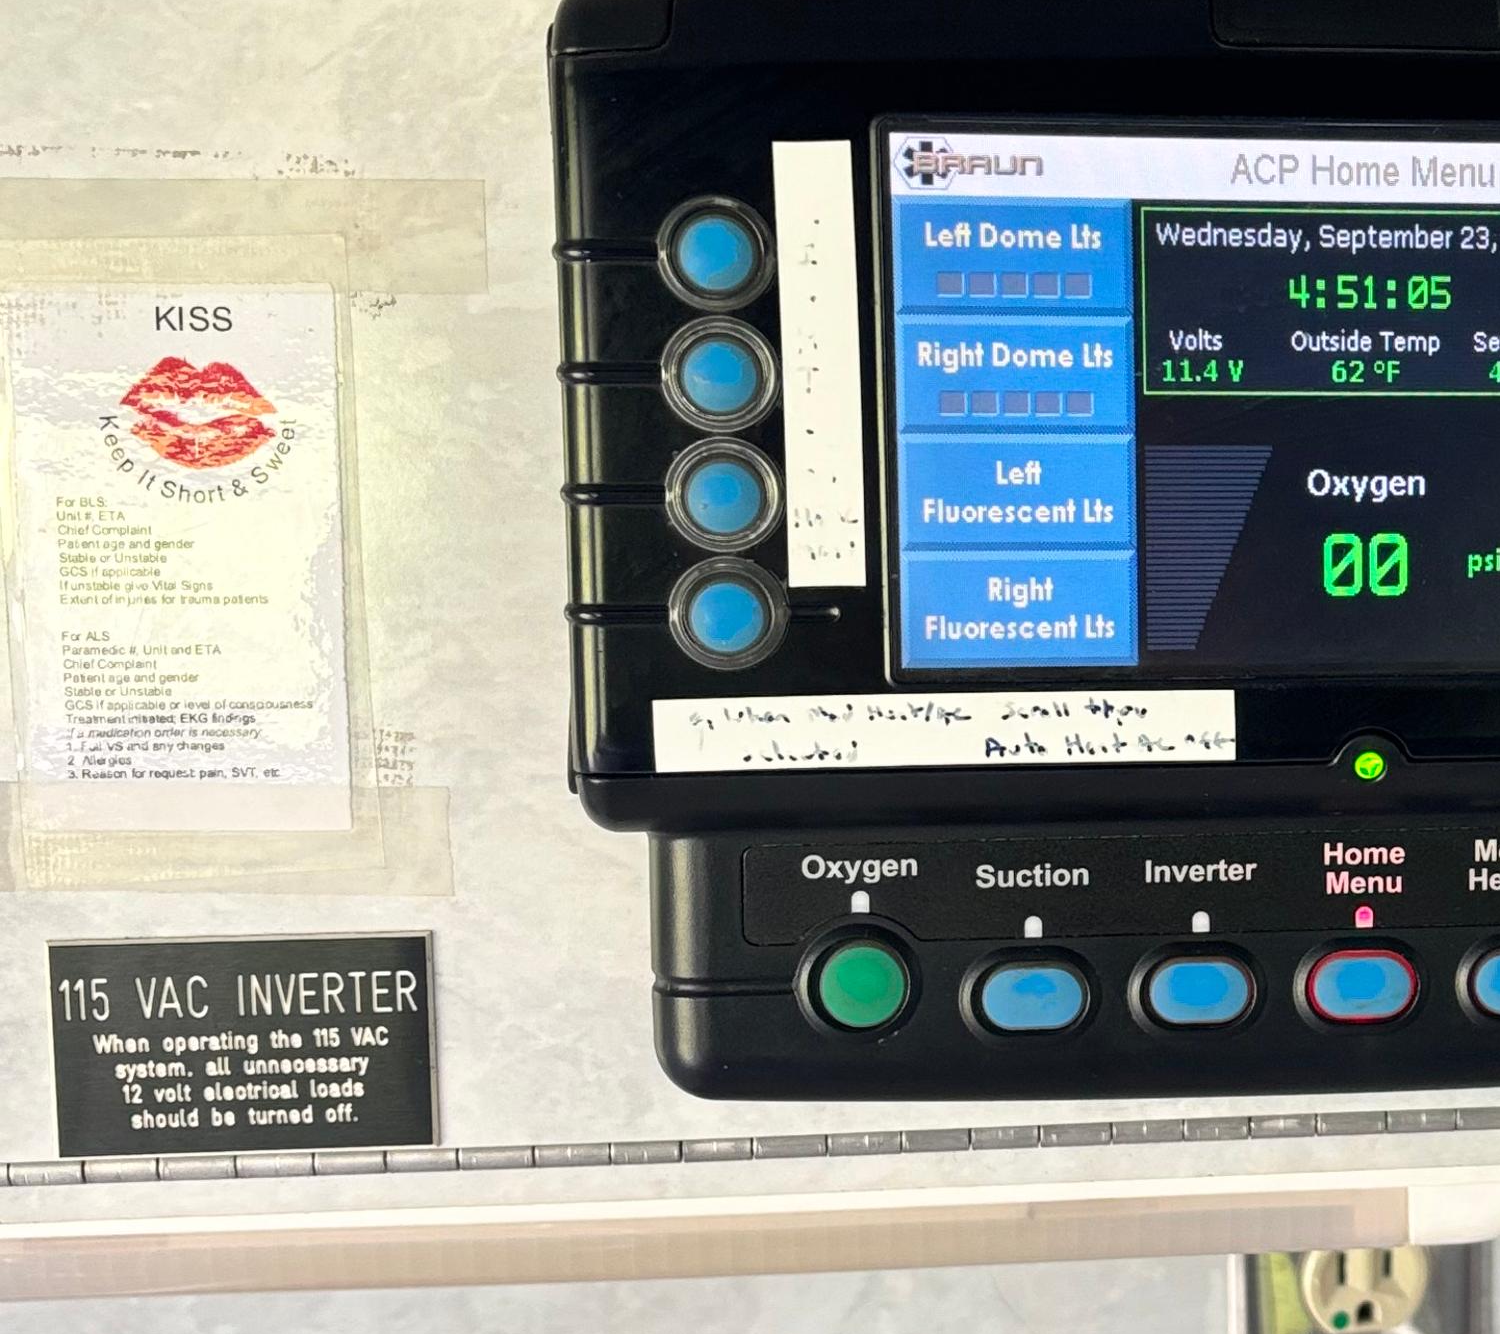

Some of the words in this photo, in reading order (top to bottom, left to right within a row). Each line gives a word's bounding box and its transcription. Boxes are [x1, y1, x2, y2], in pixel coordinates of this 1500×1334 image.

[912, 151, 1045, 177] BRAUN
[1230, 152, 1300, 186] ACP
[1310, 153, 1400, 187] Home
[1410, 155, 1497, 189] Menu
[924, 221, 971, 251] Left
[979, 223, 1062, 251] Dome
[1069, 223, 1103, 251] Lts
[1154, 221, 1312, 254] Wednesday,
[1318, 223, 1454, 254] September
[1459, 226, 1499, 254] 23,
[1287, 274, 1453, 311] 4:51:05
[154, 304, 234, 333] KISS
[1168, 328, 1223, 352] Volts
[1290, 330, 1373, 354] Outside
[1378, 331, 1442, 356] Temp
[917, 341, 985, 374] Right
[991, 344, 1074, 369] Dome
[1081, 343, 1114, 370] Lts
[1161, 359, 1219, 384] 11.4
[1227, 359, 1245, 384] V
[1330, 359, 1365, 385] 62
[98, 415, 136, 474] Keep
[136, 468, 157, 492] It
[159, 479, 227, 505] Short
[230, 478, 249, 498] &
[250, 418, 298, 485] Sweet
[995, 460, 1043, 487] Left
[1306, 468, 1426, 502] Oxygen
[55, 496, 76, 508] For
[922, 499, 1076, 524] Fluorescent
[1082, 499, 1115, 524] Lts
[55, 510, 81, 522] Unit
[98, 510, 126, 522] ETA
[57, 523, 90, 536] Chief
[91, 523, 153, 537] Complaint
[58, 551, 97, 564] Stable
[99, 554, 112, 564] or
[114, 551, 169, 564] Unstable
[102, 540, 126, 552] age
[128, 538, 151, 550] and
[153, 538, 195, 552] gender
[58, 566, 89, 578] GCS
[101, 566, 162, 579] applicable
[1321, 532, 1409, 598] 00
[69, 580, 121, 591] unstable
[123, 581, 150, 594] give
[151, 580, 177, 592] Vital
[180, 580, 214, 593] Signs
[987, 576, 1055, 608] Right
[59, 593, 100, 605] Extent
[101, 593, 114, 605] of
[160, 593, 176, 605] for
[179, 594, 221, 605] trauma
[222, 593, 270, 607] patients
[60, 630, 82, 642] For
[924, 614, 1078, 641] Fluorescent
[1084, 614, 1116, 641] Lts
[61, 644, 127, 657] Paramedic
[142, 643, 169, 656] Unit
[170, 644, 192, 656] and
[194, 643, 222, 656] ETA
[62, 658, 95, 670] Chief
[97, 658, 158, 671] Complaint
[63, 685, 103, 698] Stable
[104, 688, 117, 698] or
[119, 685, 173, 698] Unstable
[108, 674, 131, 686] age
[133, 672, 156, 684] and
[158, 672, 200, 686] gender
[64, 699, 94, 711] GCS
[106, 699, 167, 713] applicable
[168, 700, 181, 711] or
[183, 698, 212, 710] level
[214, 698, 227, 710] of
[179, 712, 209, 724] EKG
[201, 727, 261, 740] necessary
[106, 740, 125, 752] VS
[126, 740, 150, 752] and
[152, 742, 175, 754] any
[176, 740, 226, 754] changes
[81, 768, 128, 780] Reason
[131, 767, 147, 780] for
[148, 768, 197, 781] request
[1322, 842, 1406, 867] Home
[800, 853, 920, 885] Oxygen
[975, 862, 1091, 890] Suction
[1144, 858, 1258, 885] Inverter
[1324, 870, 1404, 896] Menu
[58, 977, 111, 1023] 115
[134, 973, 210, 1021] VAC
[237, 969, 419, 1018] INVERTER
[92, 1033, 150, 1056] When
[161, 1030, 260, 1055] operating
[269, 1029, 302, 1050] the
[312, 1028, 341, 1049] 115
[350, 1025, 390, 1047] VAC
[204, 1056, 231, 1077] all
[242, 1055, 371, 1078] unnecessary
[122, 1085, 144, 1105] 12
[152, 1082, 193, 1104] volt
[202, 1080, 299, 1102] electrical
[309, 1077, 366, 1100] loads
[130, 1107, 200, 1131] should
[210, 1106, 237, 1128] be
[247, 1104, 314, 1127] turned
[324, 1103, 360, 1125] off.
